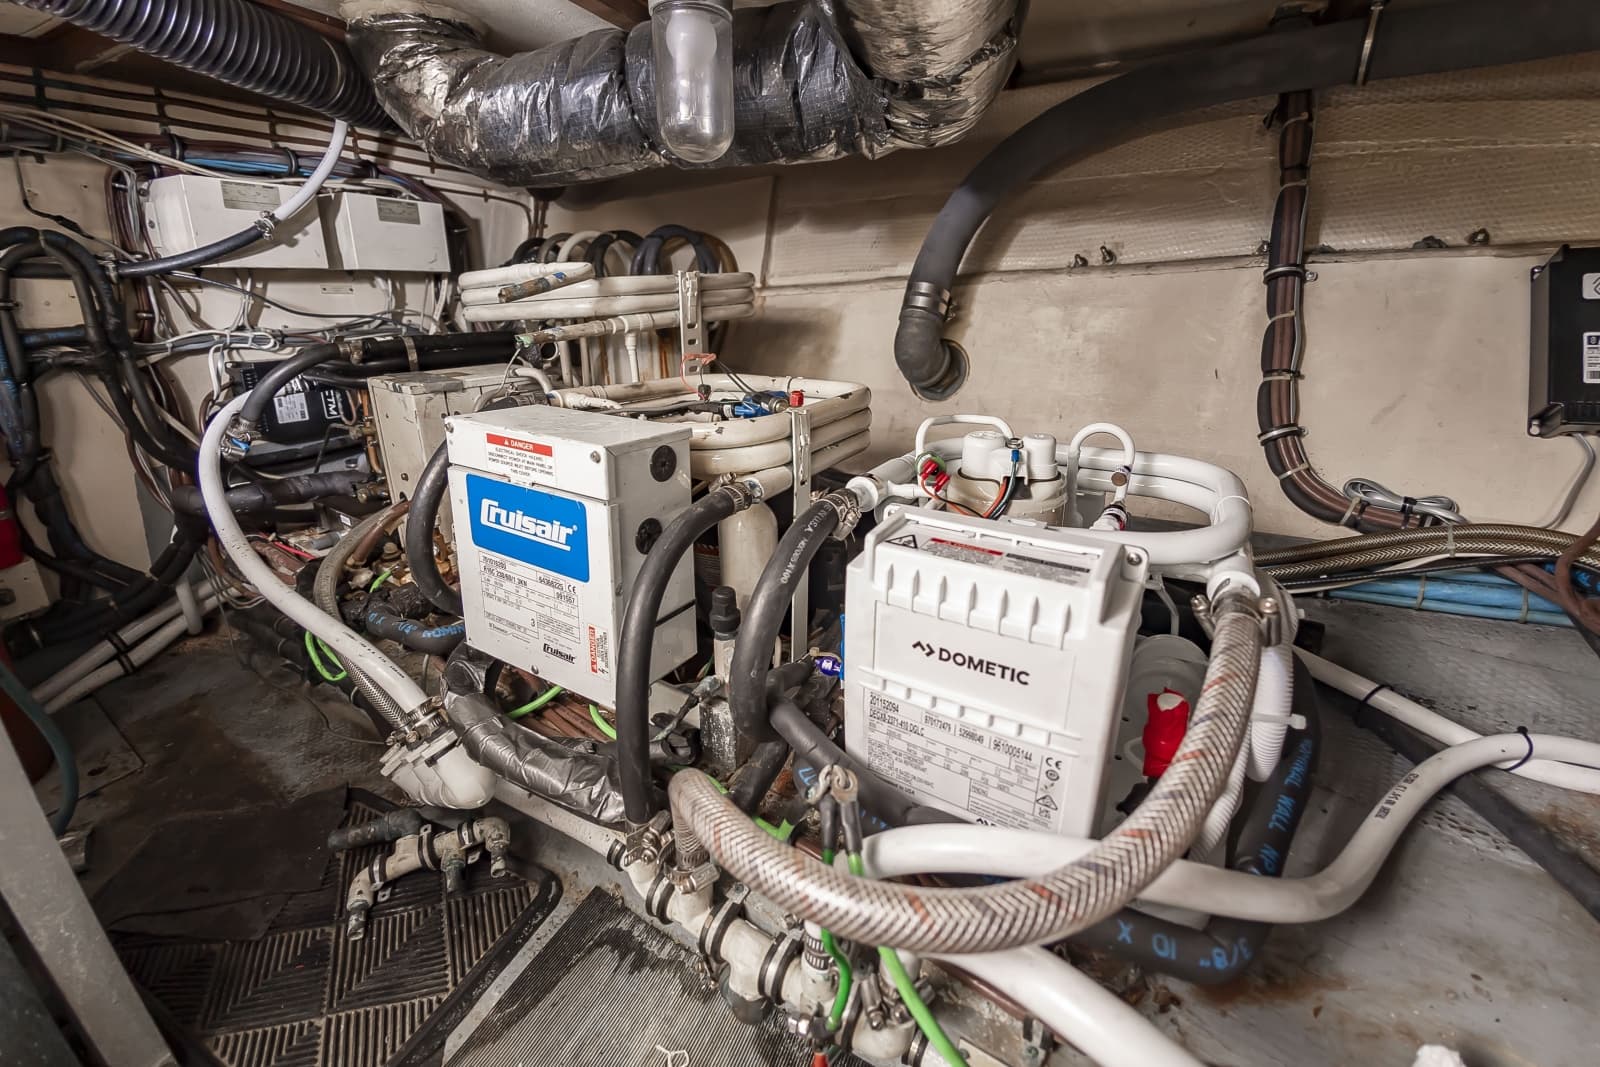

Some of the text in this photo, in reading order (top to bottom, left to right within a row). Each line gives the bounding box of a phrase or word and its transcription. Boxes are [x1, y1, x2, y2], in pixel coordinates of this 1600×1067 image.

[510, 439, 534, 451] DANGER
[480, 498, 574, 550] Cruisair
[543, 642, 577, 664] Cruisair
[589, 628, 597, 662] DANGER
[938, 647, 1030, 686] DOMETIC
[1268, 794, 1296, 831] WALL
[1152, 932, 1177, 960] ID
